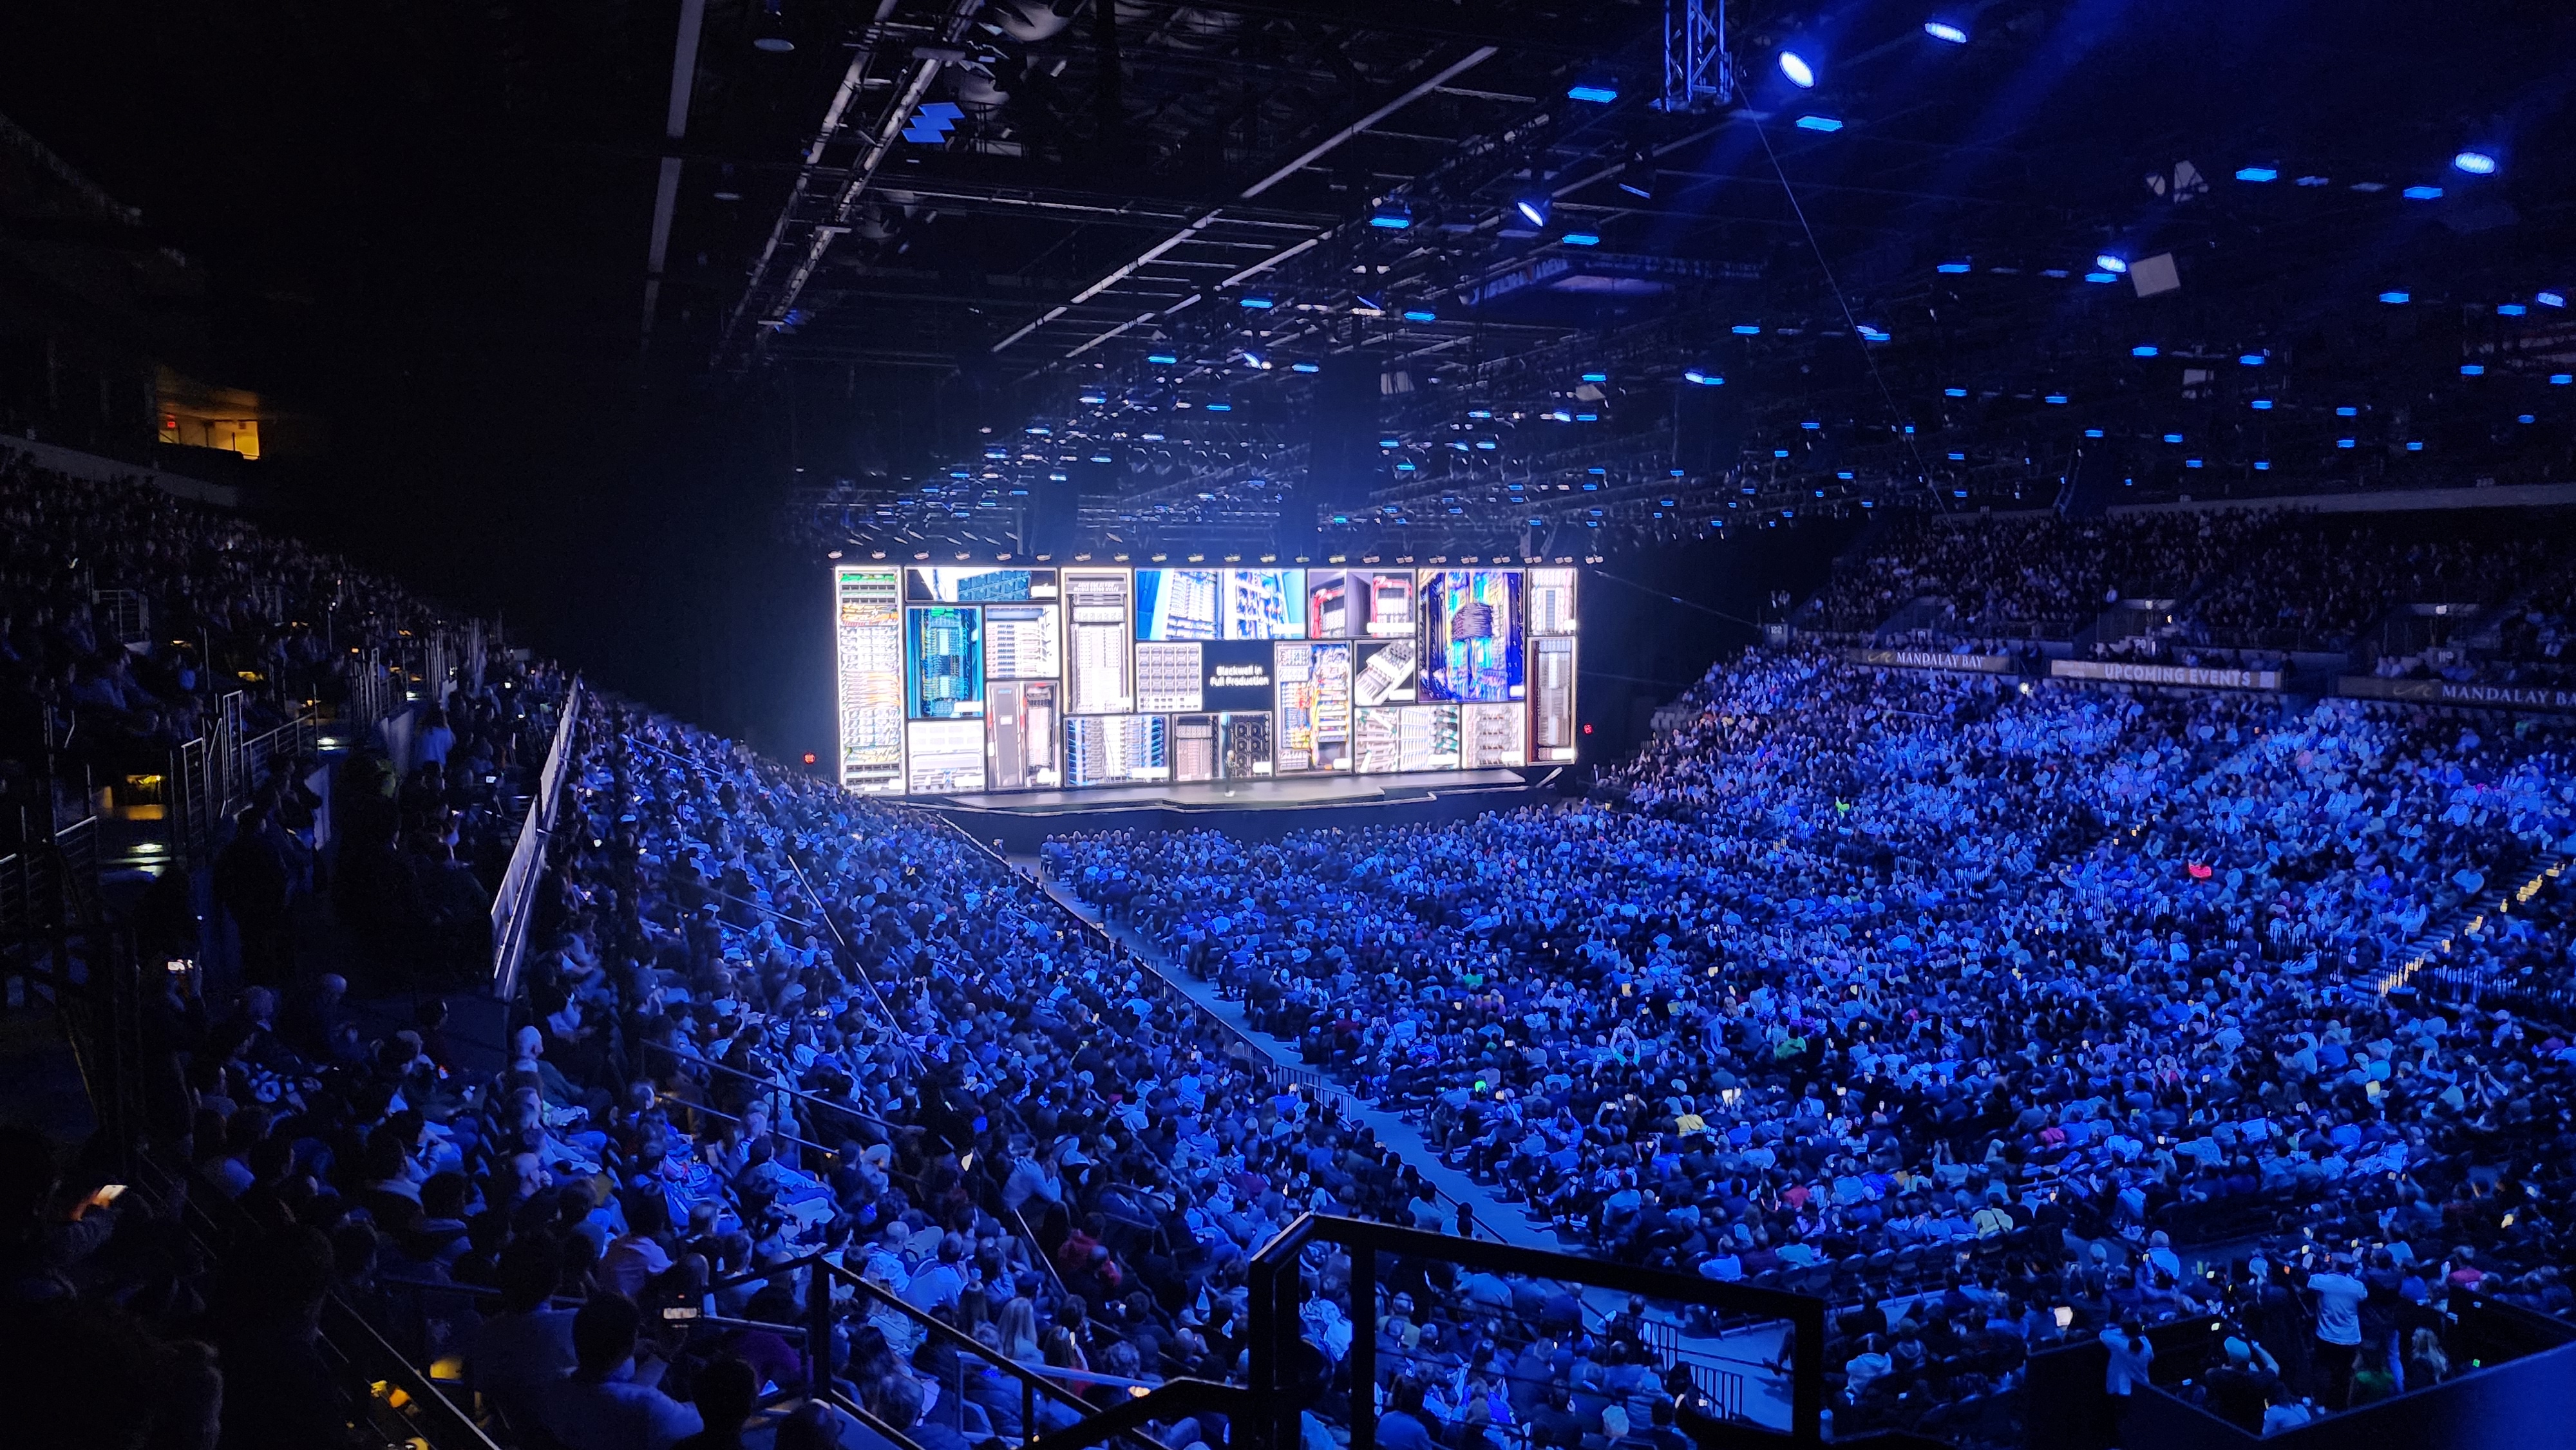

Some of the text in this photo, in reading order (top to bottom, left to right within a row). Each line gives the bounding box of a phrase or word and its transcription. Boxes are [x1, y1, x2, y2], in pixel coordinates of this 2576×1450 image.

[1897, 652, 1984, 668] MANDALAY BAY
[1217, 665, 1263, 676] Blackwell in
[2105, 664, 2184, 683] UPCOMING
[2190, 669, 2251, 687] EVENTS
[1210, 676, 1269, 687] Full Production
[2442, 684, 2549, 704] MANDALAY
